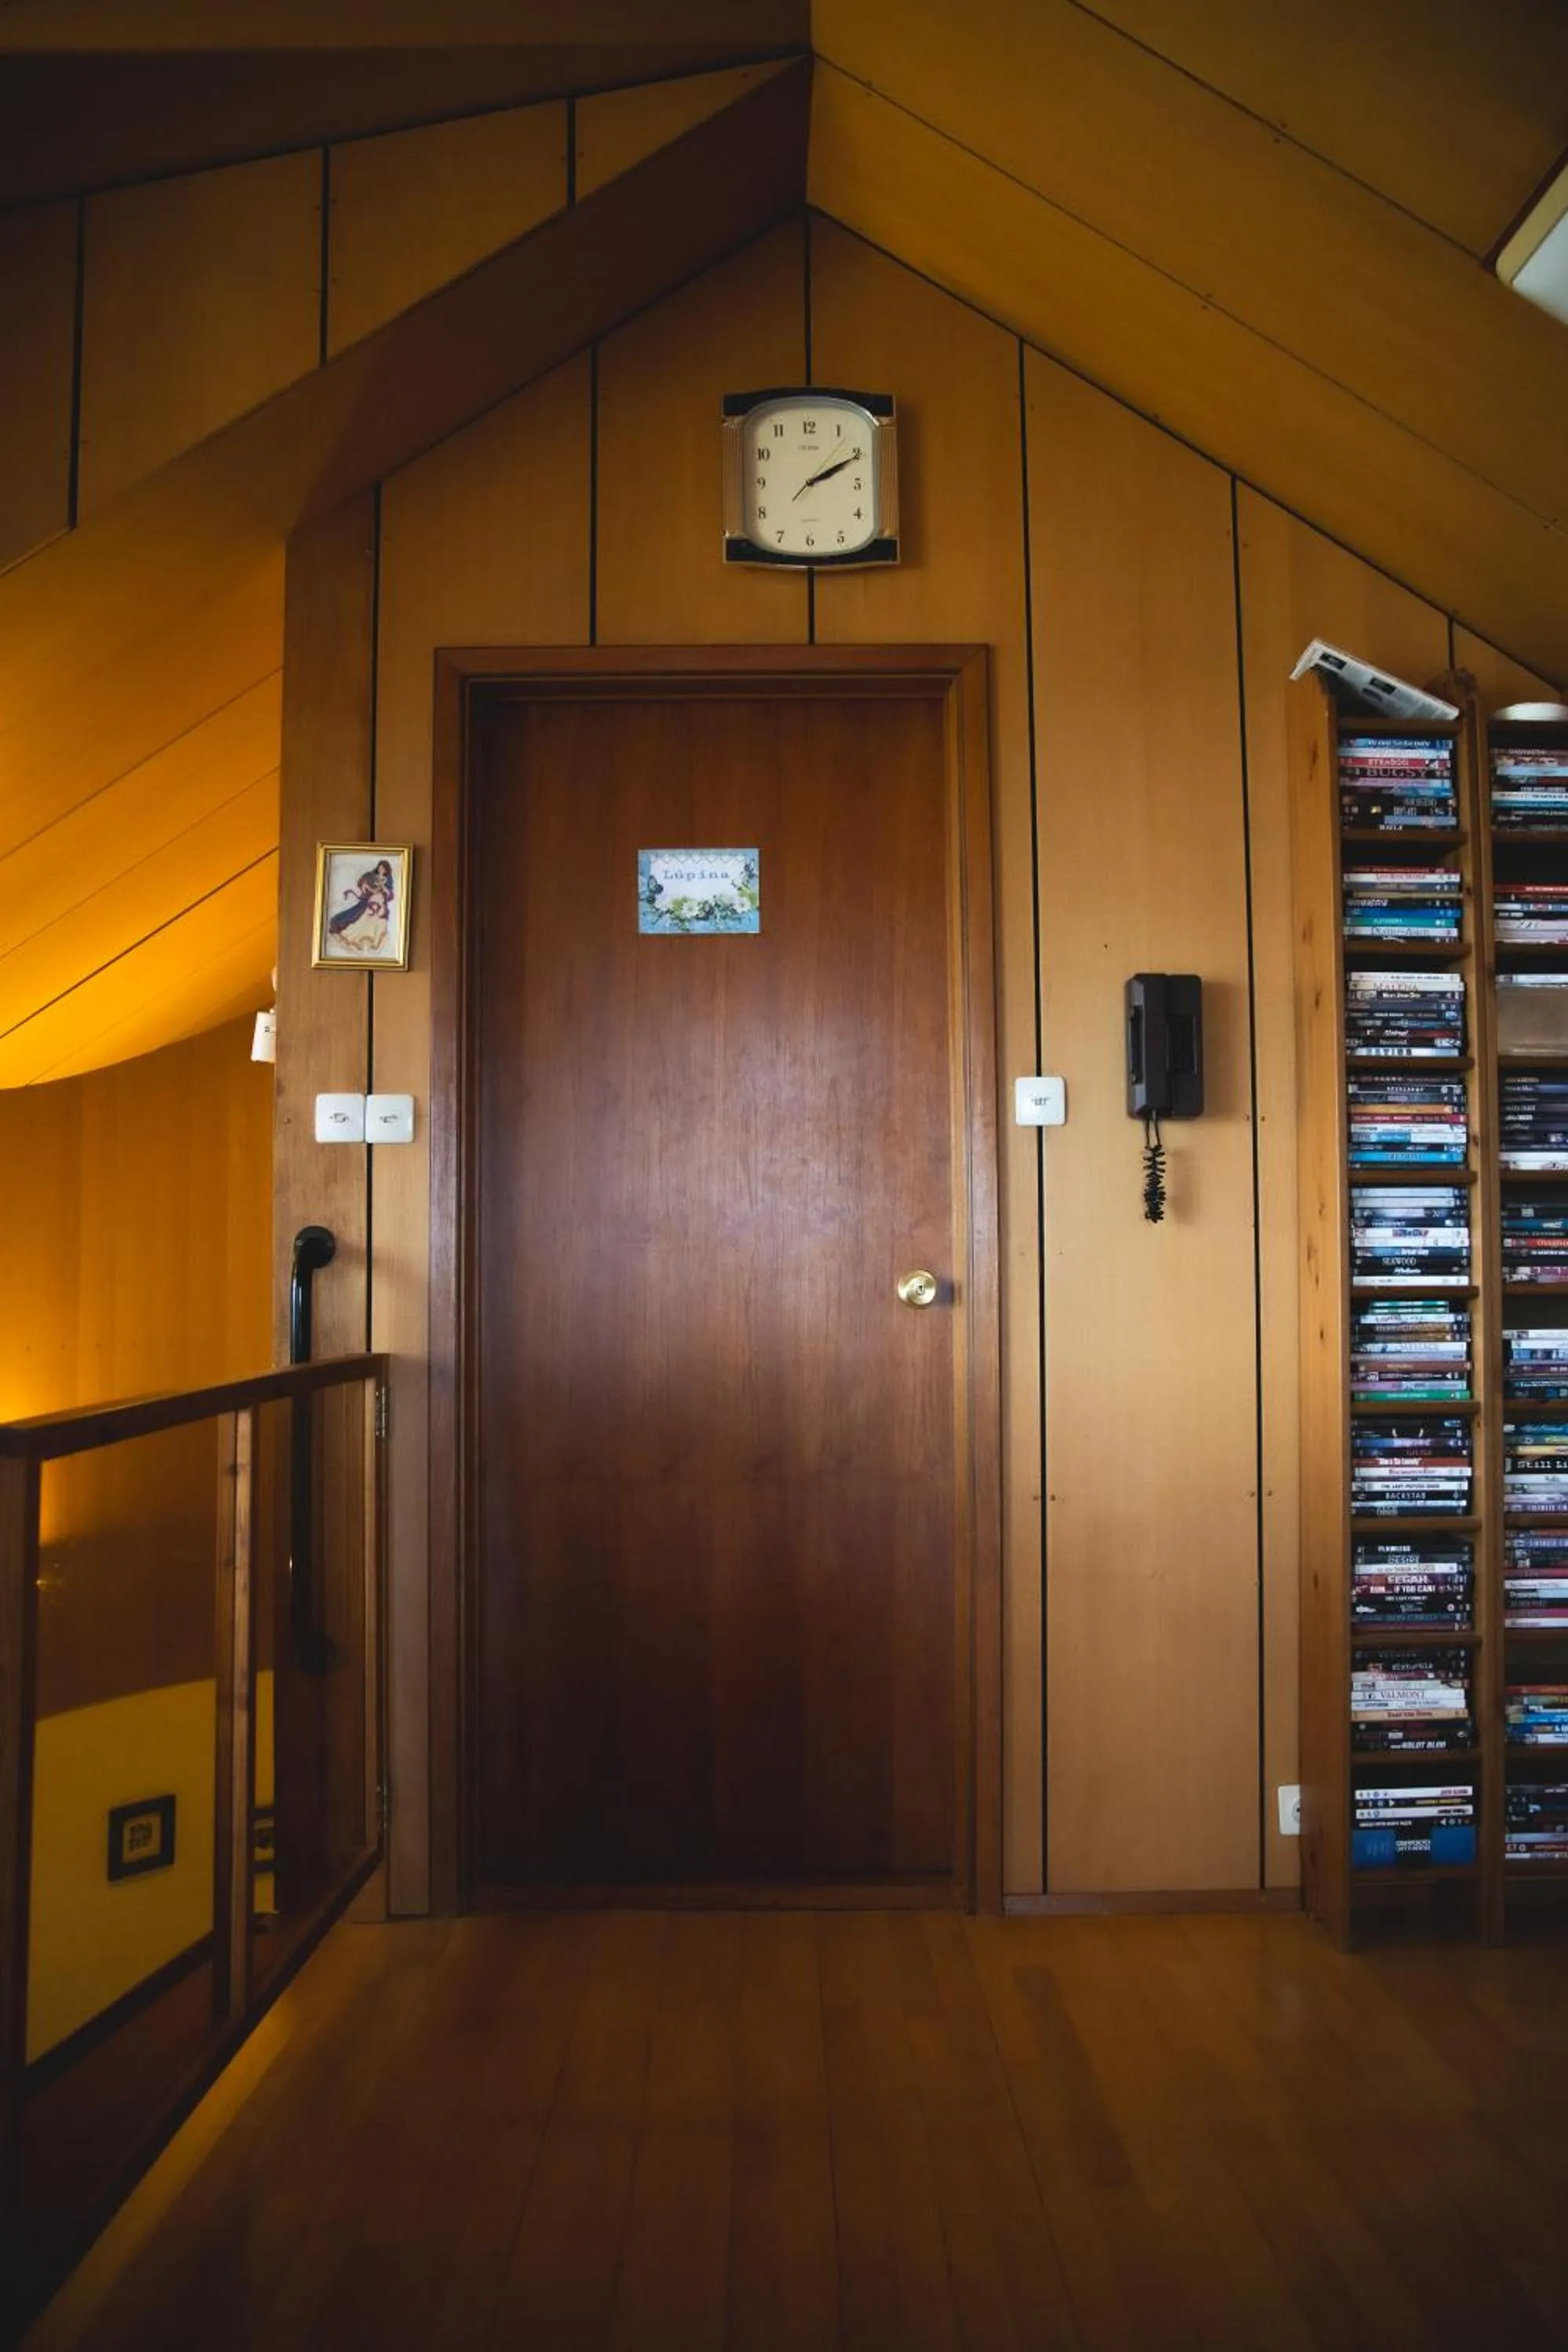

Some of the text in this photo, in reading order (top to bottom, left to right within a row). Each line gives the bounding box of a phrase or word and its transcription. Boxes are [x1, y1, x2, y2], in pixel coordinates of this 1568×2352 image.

[772, 424, 784, 437] 11
[802, 420, 816, 434] 12
[834, 425, 841, 437] 1
[757, 448, 771, 460] 10
[852, 447, 862, 460] 2
[757, 477, 766, 490] 9
[853, 477, 862, 491] 3
[757, 506, 767, 519] 8
[853, 507, 862, 520] 4
[776, 530, 786, 543] 7
[805, 533, 815, 546] 6
[837, 531, 844, 543] 5
[1366, 768, 1428, 778] BUGSY
